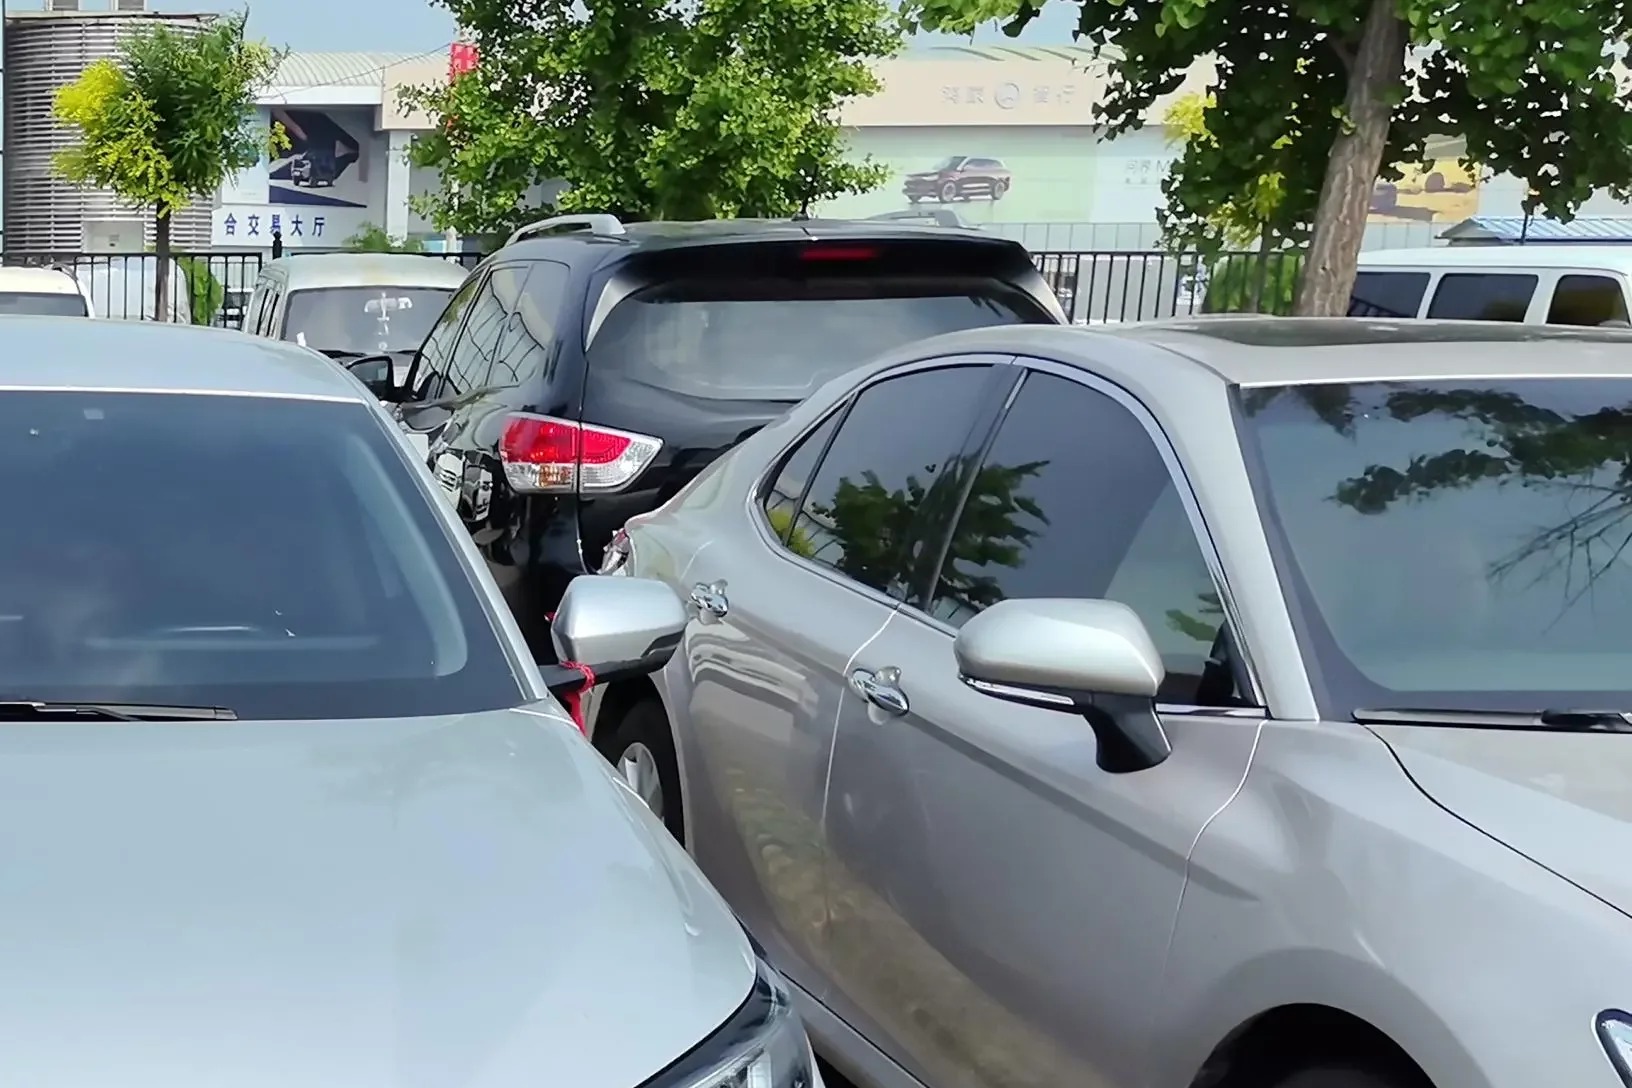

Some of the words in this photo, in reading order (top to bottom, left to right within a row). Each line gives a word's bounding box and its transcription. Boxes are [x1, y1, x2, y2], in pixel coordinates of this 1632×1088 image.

[223, 212, 325, 237] 合交易大厅
